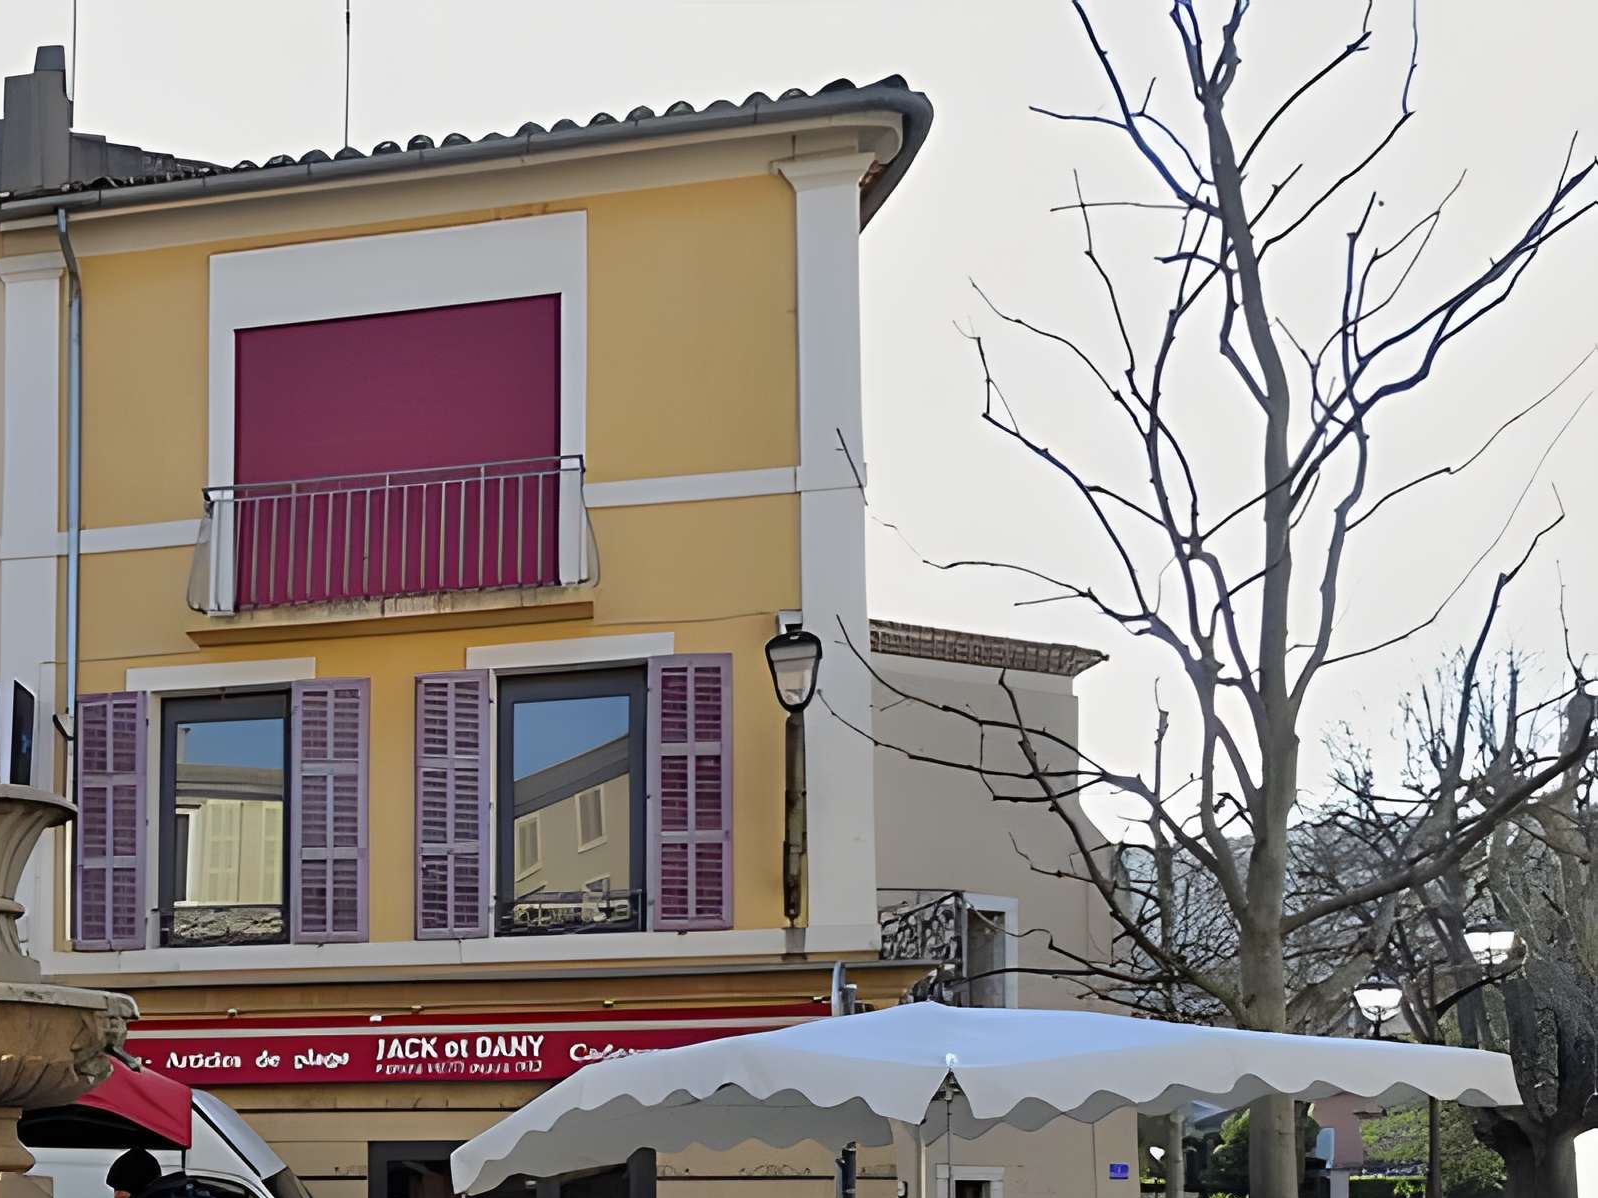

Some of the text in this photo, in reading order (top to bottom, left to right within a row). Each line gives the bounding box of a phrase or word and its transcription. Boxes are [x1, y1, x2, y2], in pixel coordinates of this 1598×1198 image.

[375, 1036, 438, 1060] JACK
[476, 1035, 544, 1058] DANY
[256, 1050, 281, 1068] de
